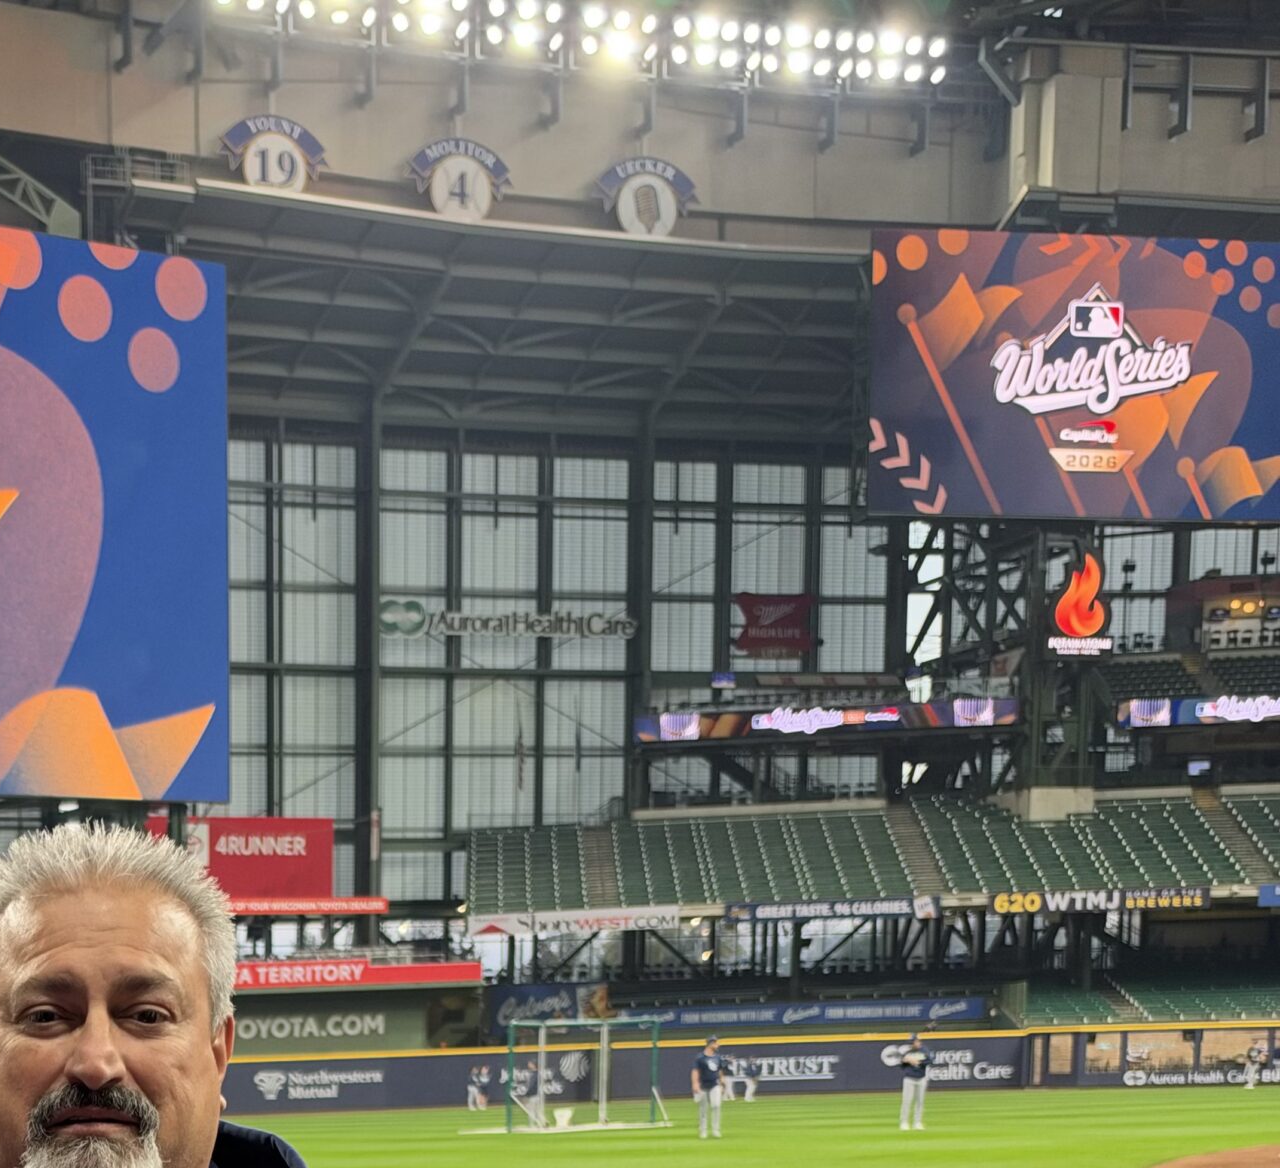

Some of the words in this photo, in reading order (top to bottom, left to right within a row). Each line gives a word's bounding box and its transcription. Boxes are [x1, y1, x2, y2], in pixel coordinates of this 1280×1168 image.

[424, 139, 498, 169] MOLITOR
[254, 148, 297, 185] 19
[615, 158, 676, 181] UECKER
[448, 170, 469, 210] 4
[993, 338, 1108, 403] World
[1086, 338, 1193, 415] Series
[1065, 454, 1118, 469] 2026
[434, 611, 504, 635] Aurora
[513, 612, 579, 637] Health
[585, 613, 638, 639] Care
[214, 835, 307, 857] 4RUNNER
[755, 904, 794, 919] GREAT
[834, 901, 851, 916] 96
[994, 892, 1042, 914] 620
[1044, 889, 1120, 911] WTMJ
[1125, 896, 1203, 909] BREWERS
[256, 964, 366, 984] TERRITORY
[236, 1013, 386, 1040] OYOTA.COM
[931, 1049, 973, 1064] urora
[288, 1068, 385, 1085] Northwestern
[973, 1061, 1014, 1080] Care
[1148, 1071, 1185, 1085] Aurora
[1187, 1070, 1225, 1084] Health
[288, 1084, 339, 1100] Mutual
